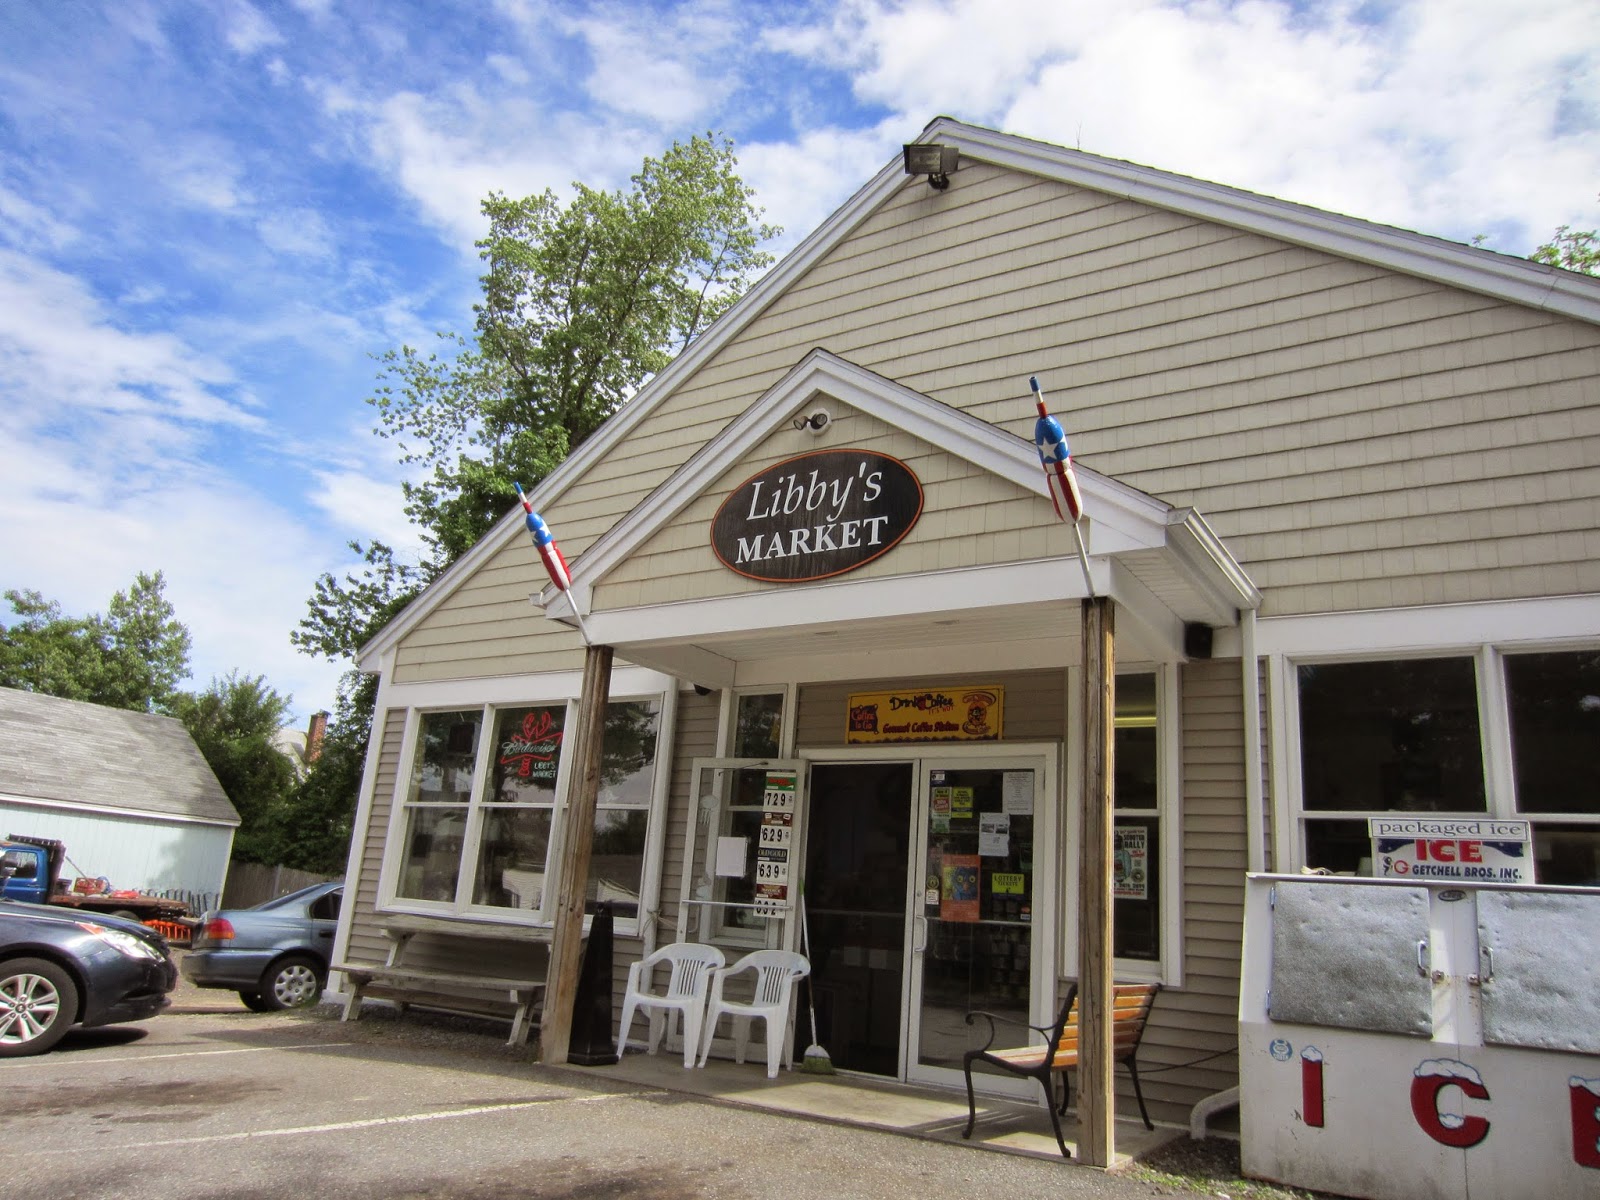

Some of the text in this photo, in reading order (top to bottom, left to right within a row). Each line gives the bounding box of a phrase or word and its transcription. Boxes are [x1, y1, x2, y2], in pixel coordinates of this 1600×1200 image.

[746, 462, 883, 523] Libby's
[735, 516, 888, 564] MARKET
[502, 741, 557, 755] Budweiser
[1379, 822, 1521, 836] packaged ice
[1414, 839, 1483, 863] ICE
[1412, 865, 1461, 877] GETCHELL
[1464, 867, 1497, 878] BROS.
[1500, 868, 1523, 879] INC.
